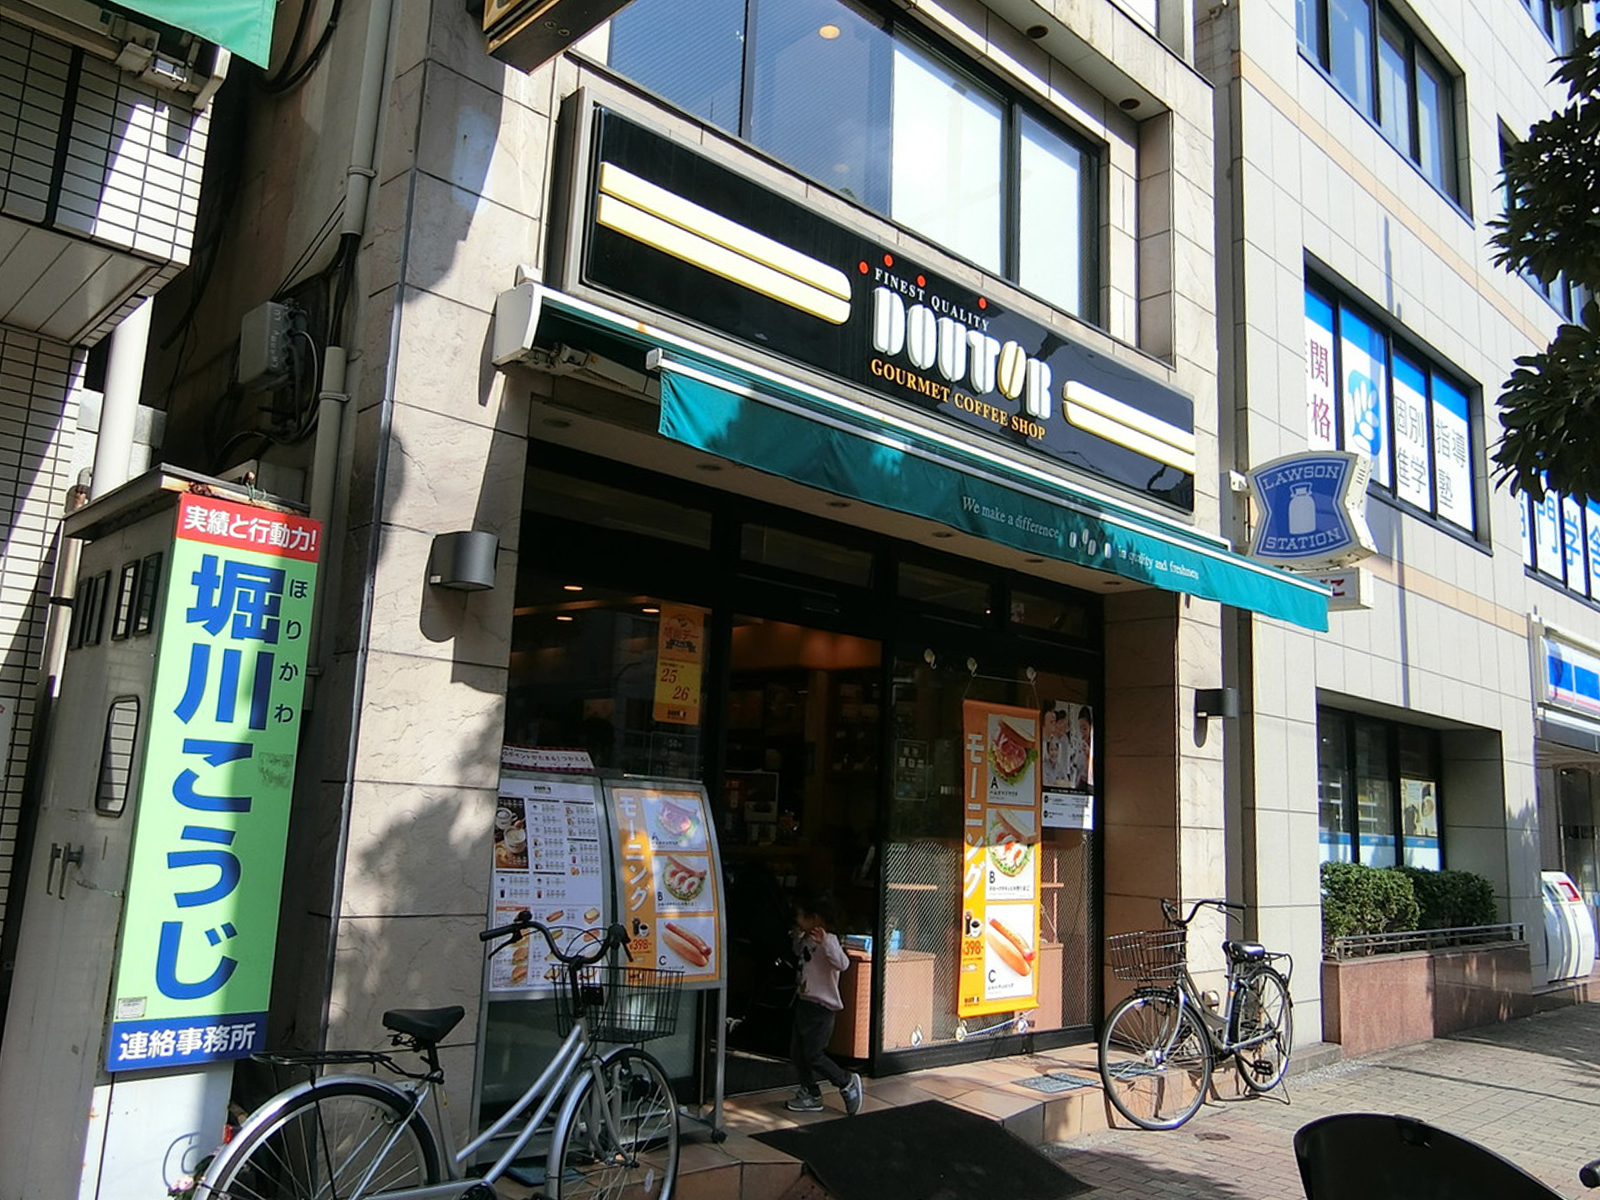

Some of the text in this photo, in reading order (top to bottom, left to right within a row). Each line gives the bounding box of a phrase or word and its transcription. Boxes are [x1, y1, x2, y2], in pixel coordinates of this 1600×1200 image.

[874, 268, 990, 332] FINEST QUALITY
[872, 286, 1052, 421] DOUTOR
[1304, 338, 1329, 388] 関
[871, 358, 1047, 440] GOURMET COFFEE SHOP
[1262, 465, 1340, 491] LAWSON
[183, 505, 317, 552] 実績と行動力!
[962, 496, 980, 514] We
[981, 507, 1006, 523] make
[1007, 514, 1015, 526] a
[1015, 515, 1061, 539] difference
[1265, 527, 1342, 551] STATION
[273, 578, 308, 723] ほりかわ
[660, 667, 678, 684] 25
[672, 685, 690, 701] 26
[156, 554, 286, 1001] 堀川こうじ
[990, 776, 999, 789] A
[964, 733, 985, 898] モーニング
[619, 797, 651, 911] モーニング
[989, 870, 996, 884] B
[658, 955, 667, 966] C
[988, 969, 997, 983] C
[117, 1021, 257, 1062] 連絡事務所
